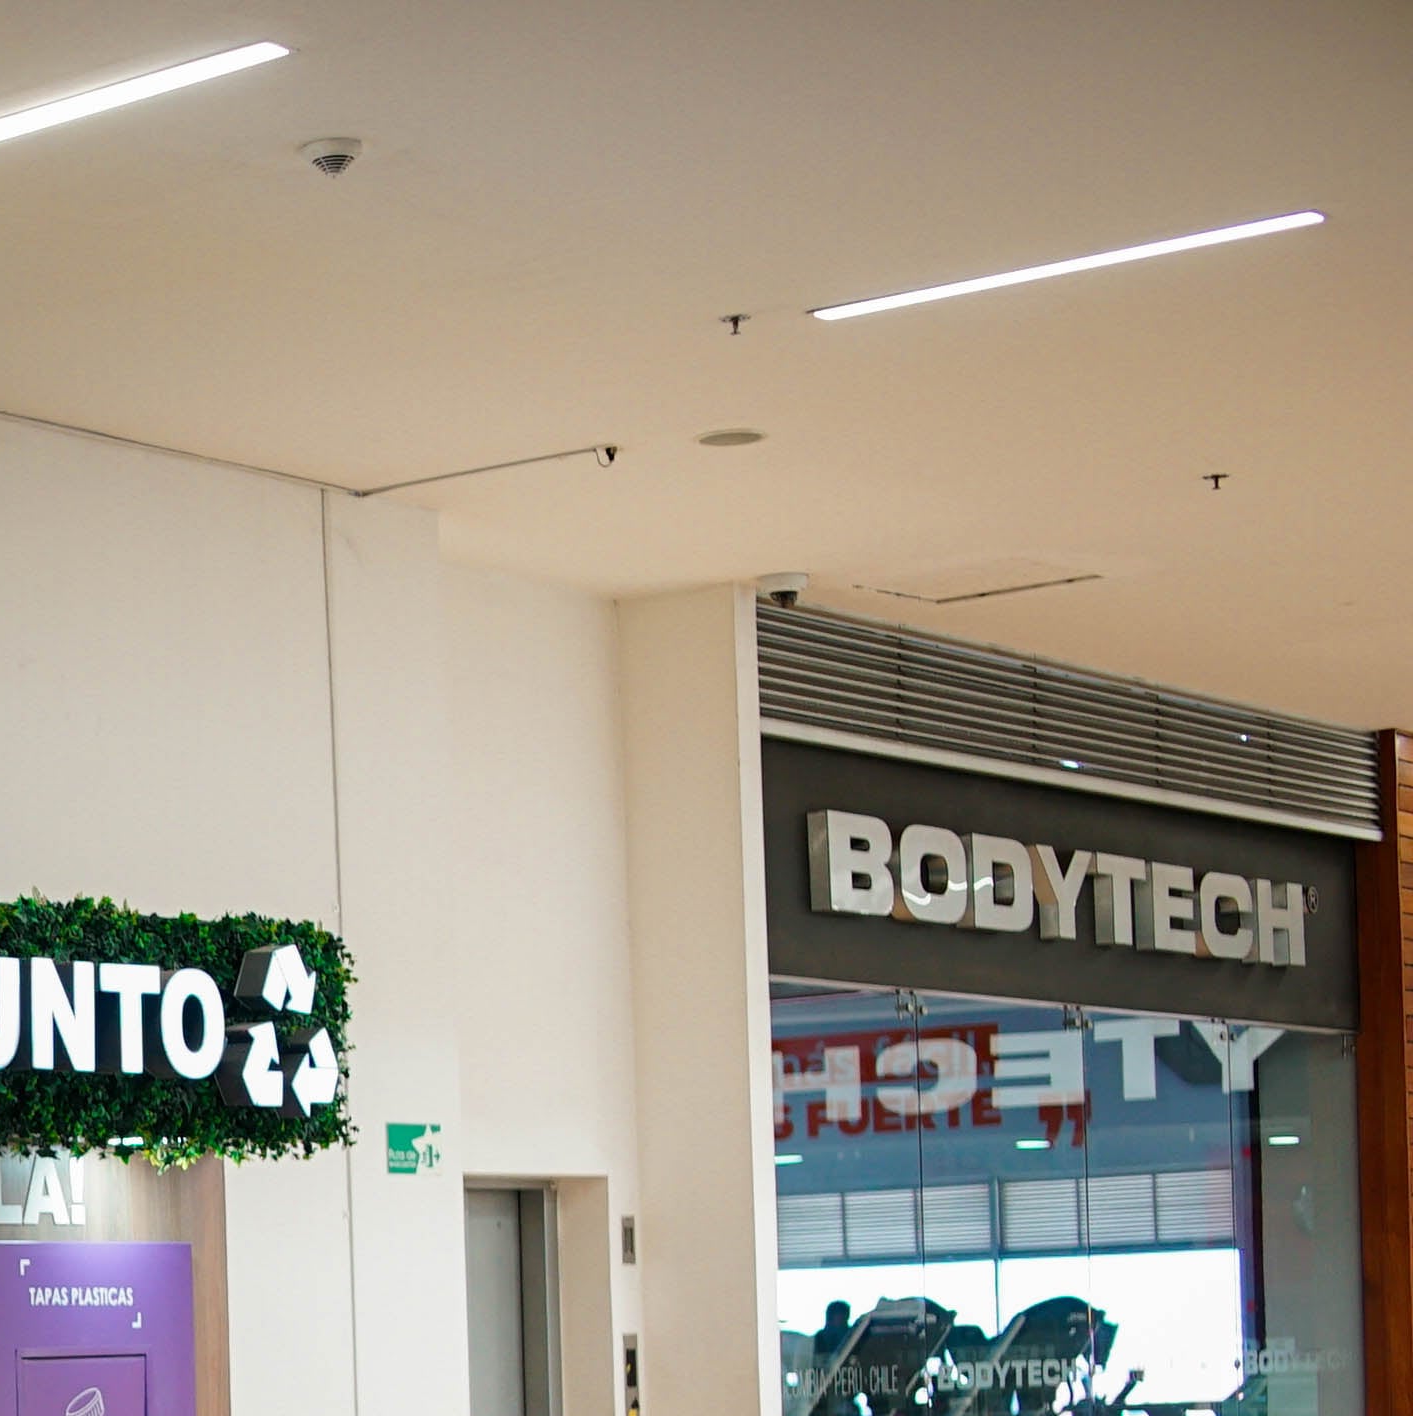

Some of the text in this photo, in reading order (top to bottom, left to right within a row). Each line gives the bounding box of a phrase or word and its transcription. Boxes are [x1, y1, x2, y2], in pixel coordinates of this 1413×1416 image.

[818, 809, 1307, 968] BODYTECH
[28, 1286, 134, 1307] TAPAS PLASTICAS
[937, 1358, 1077, 1391] BODYTECH
